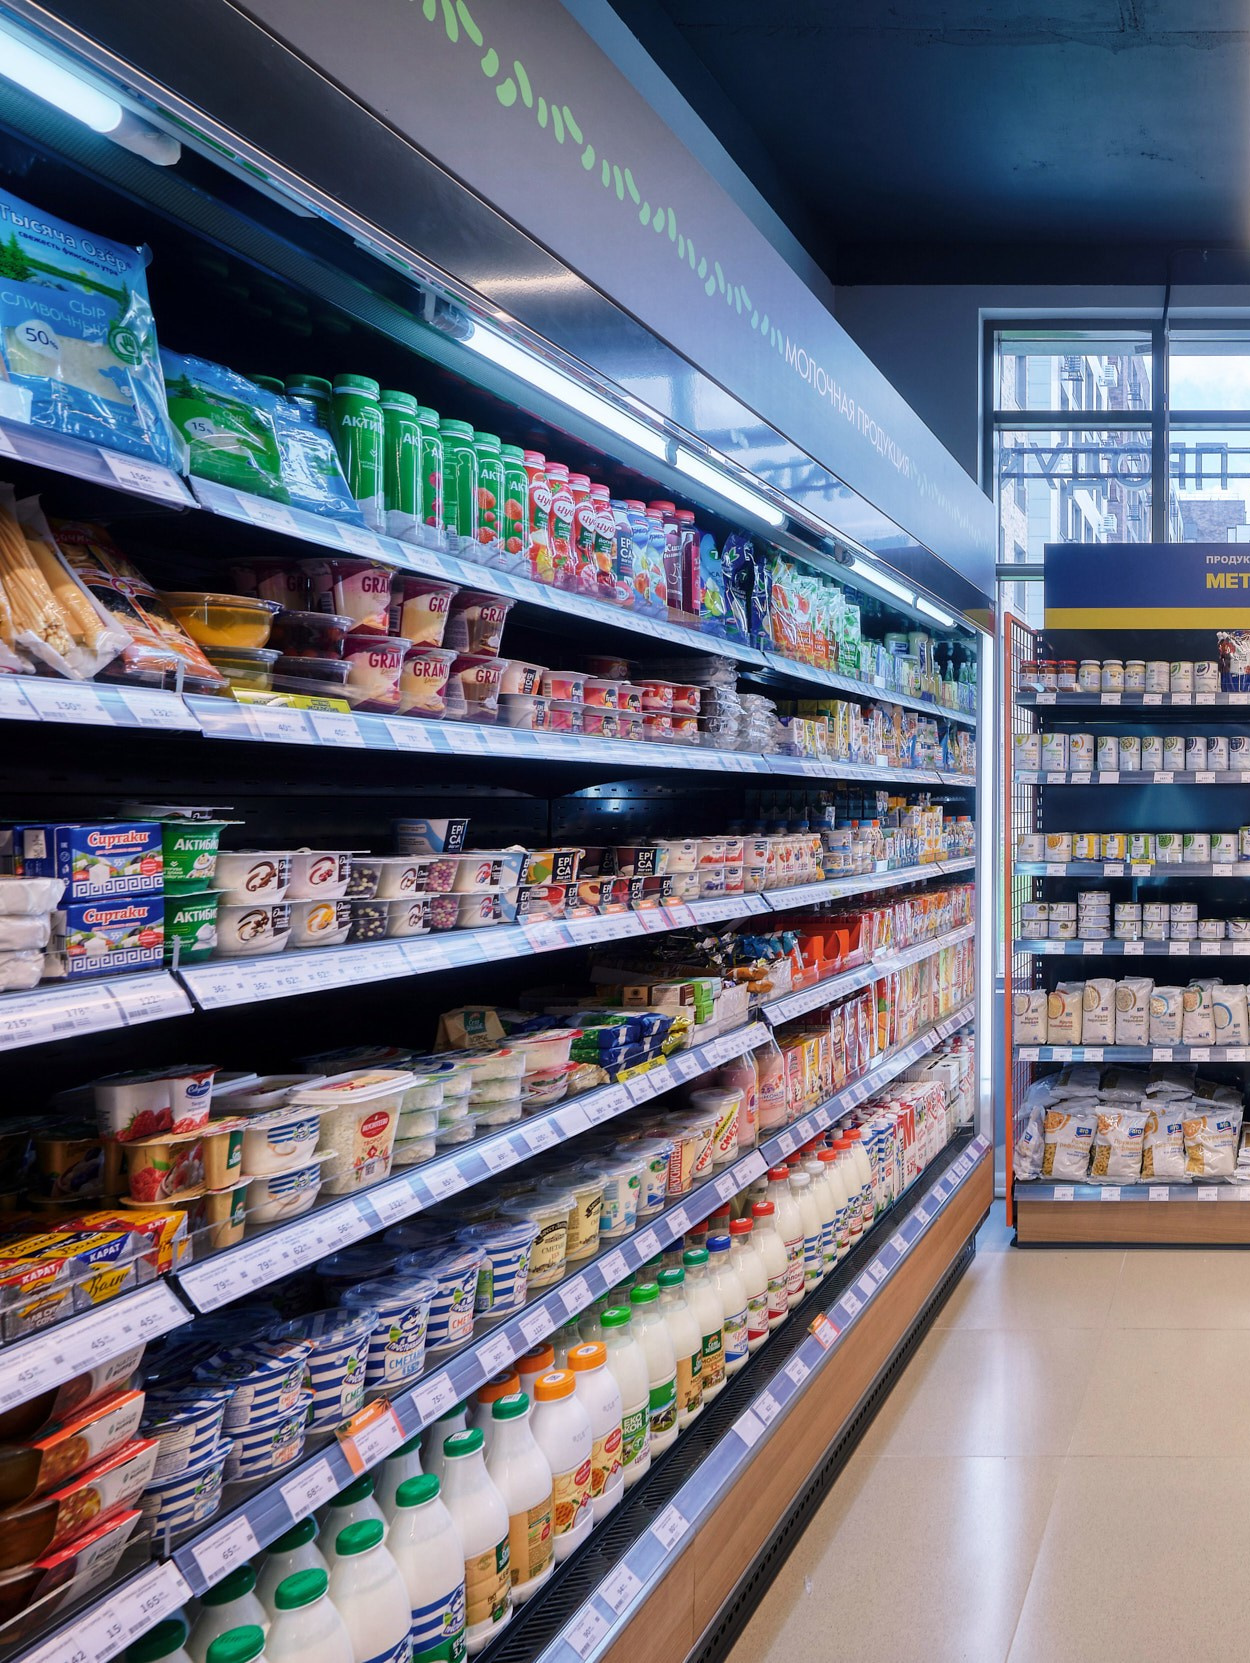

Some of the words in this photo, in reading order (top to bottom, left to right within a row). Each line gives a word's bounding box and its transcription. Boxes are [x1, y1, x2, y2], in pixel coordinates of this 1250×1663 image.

[0, 203, 77, 249] Тысяча
[81, 238, 128, 274] Озёр
[69, 299, 106, 317] СЫР
[25, 327, 50, 347] 50
[785, 335, 855, 425] МОЛОЧНАЯ
[857, 405, 910, 478] ПРОДУКЦИЯ
[361, 576, 391, 594] GRA
[368, 651, 401, 670] GRAN
[87, 830, 149, 849] Сиртаки
[83, 905, 148, 925] Сиртаки
[89, 1242, 121, 1263] КАРАТ
[22, 1259, 60, 1285] КАРАТ
